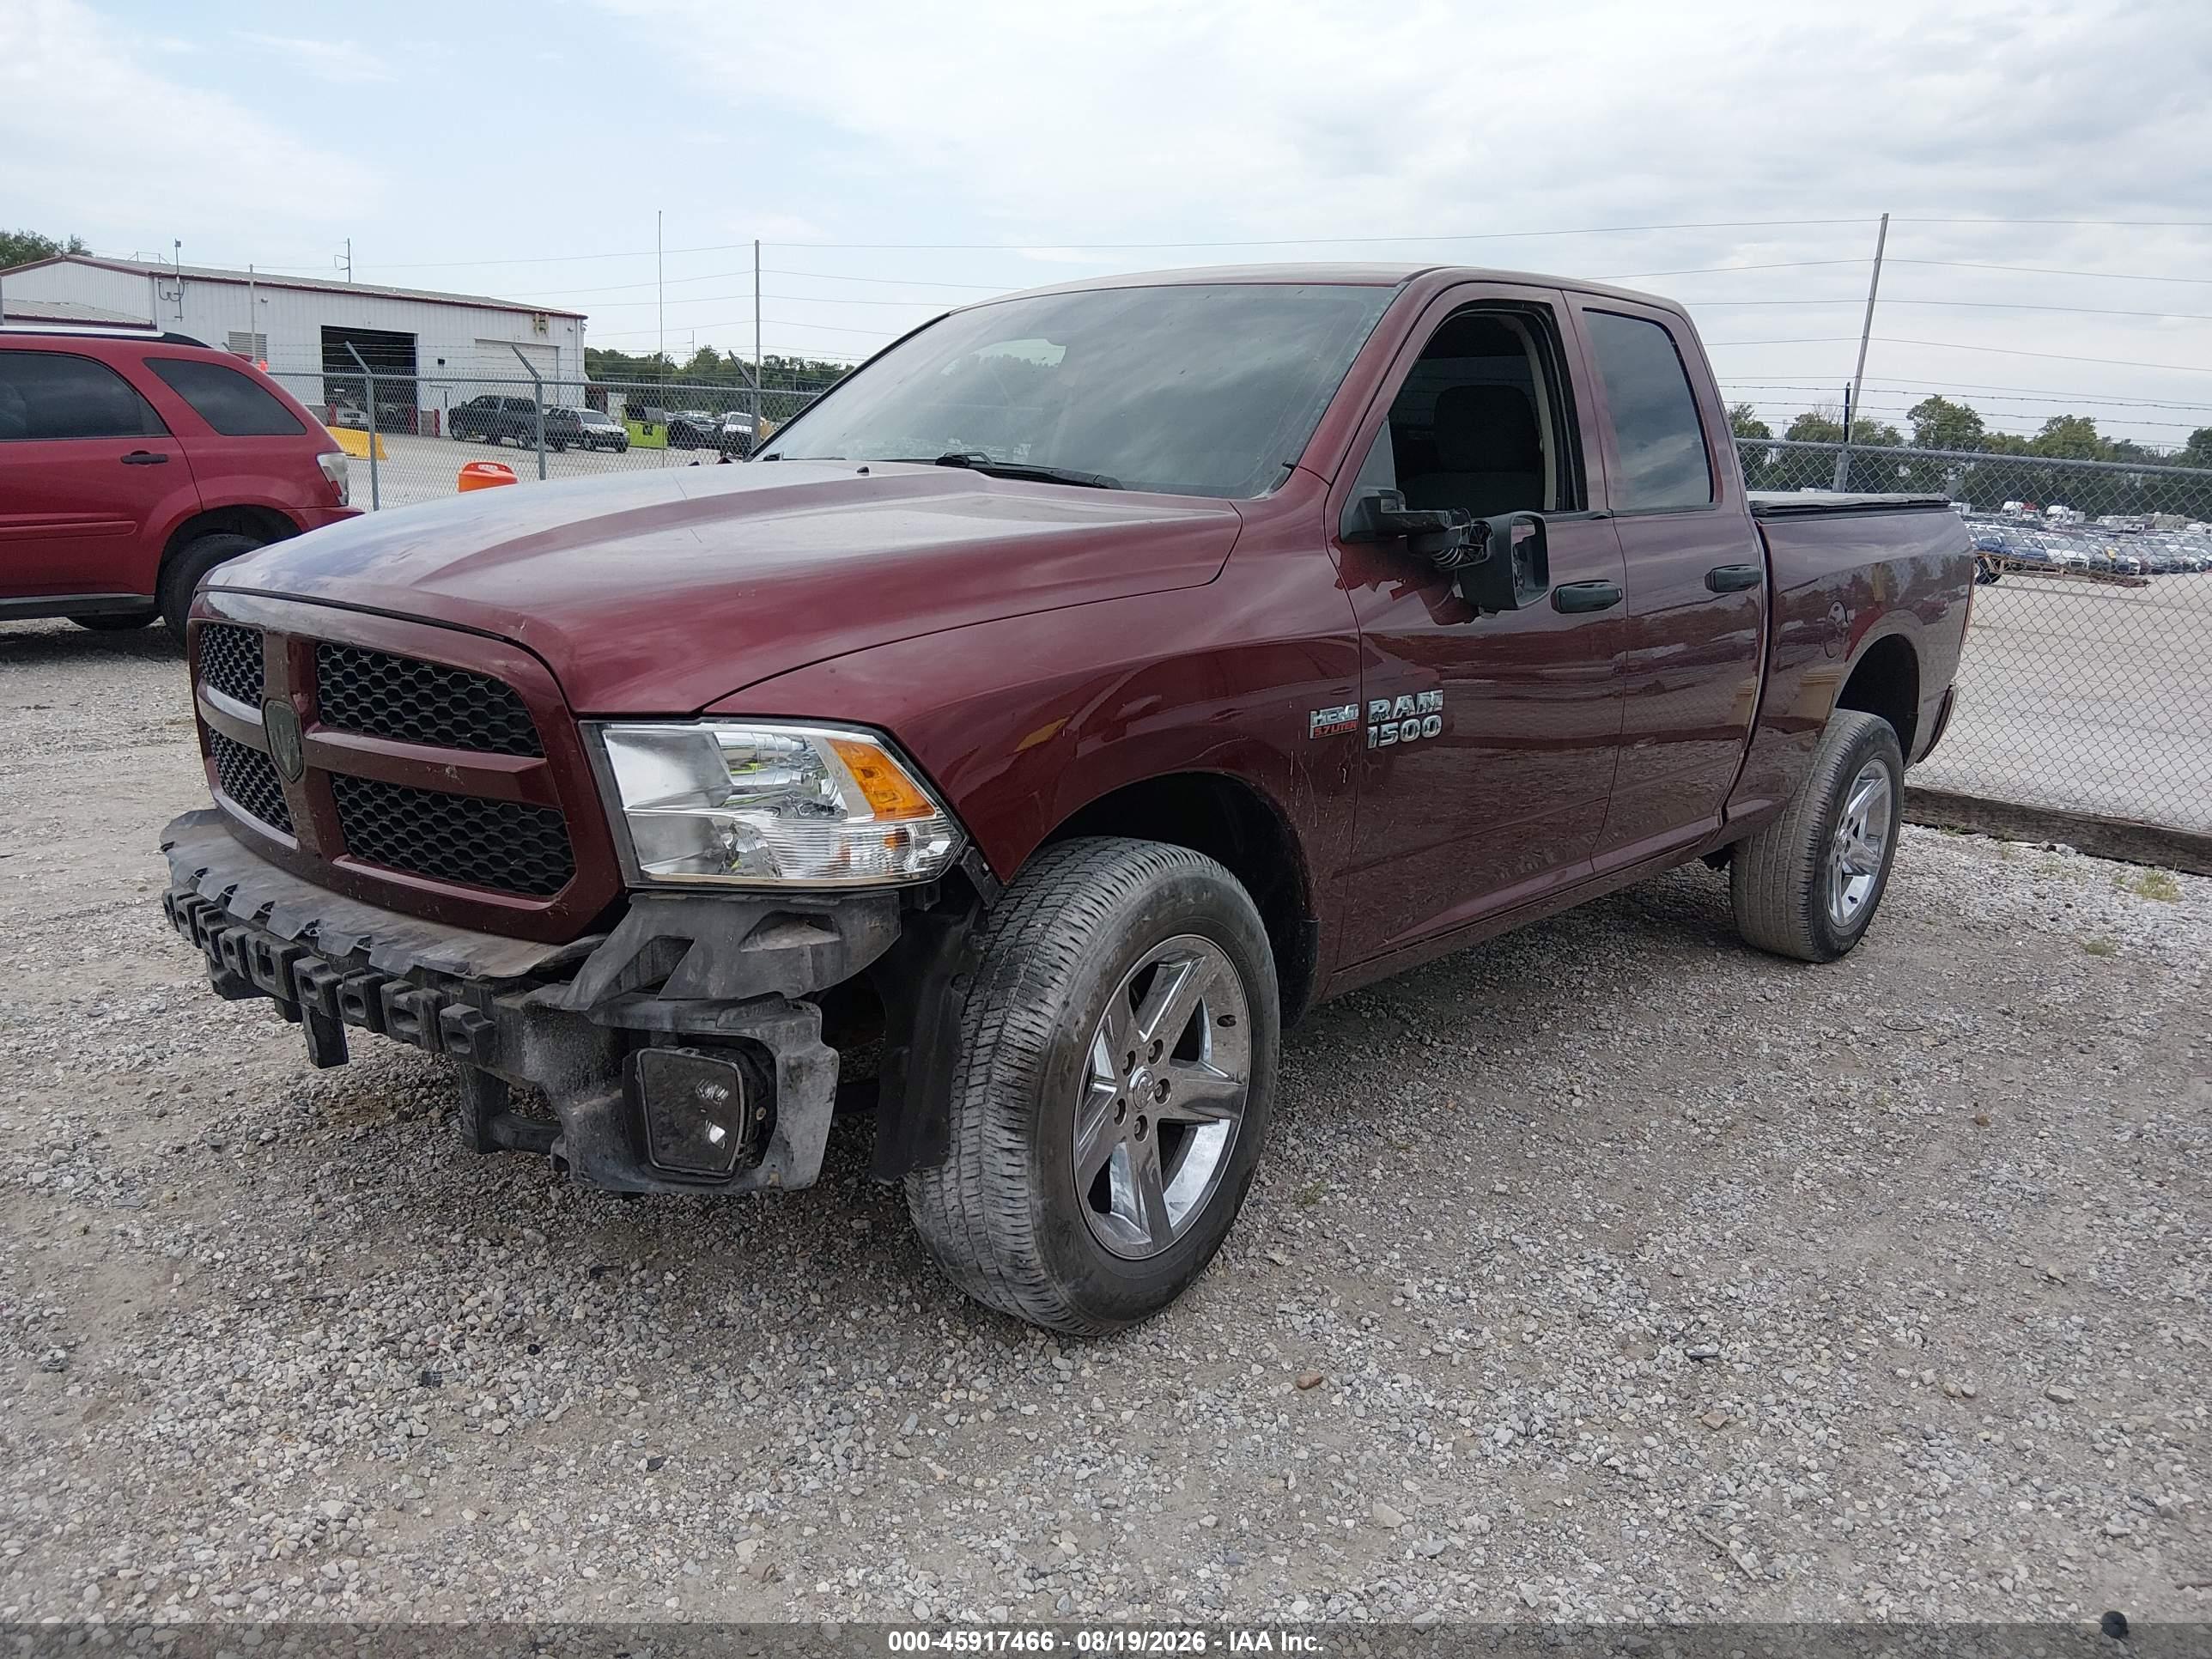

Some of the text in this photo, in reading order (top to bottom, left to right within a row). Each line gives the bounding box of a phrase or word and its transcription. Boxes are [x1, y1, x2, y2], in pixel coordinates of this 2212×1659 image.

[1311, 704, 1359, 727] HEMI
[1368, 690, 1443, 724] RAM
[1315, 720, 1358, 737] 5.7 LITER
[1367, 714, 1442, 749] 1500
